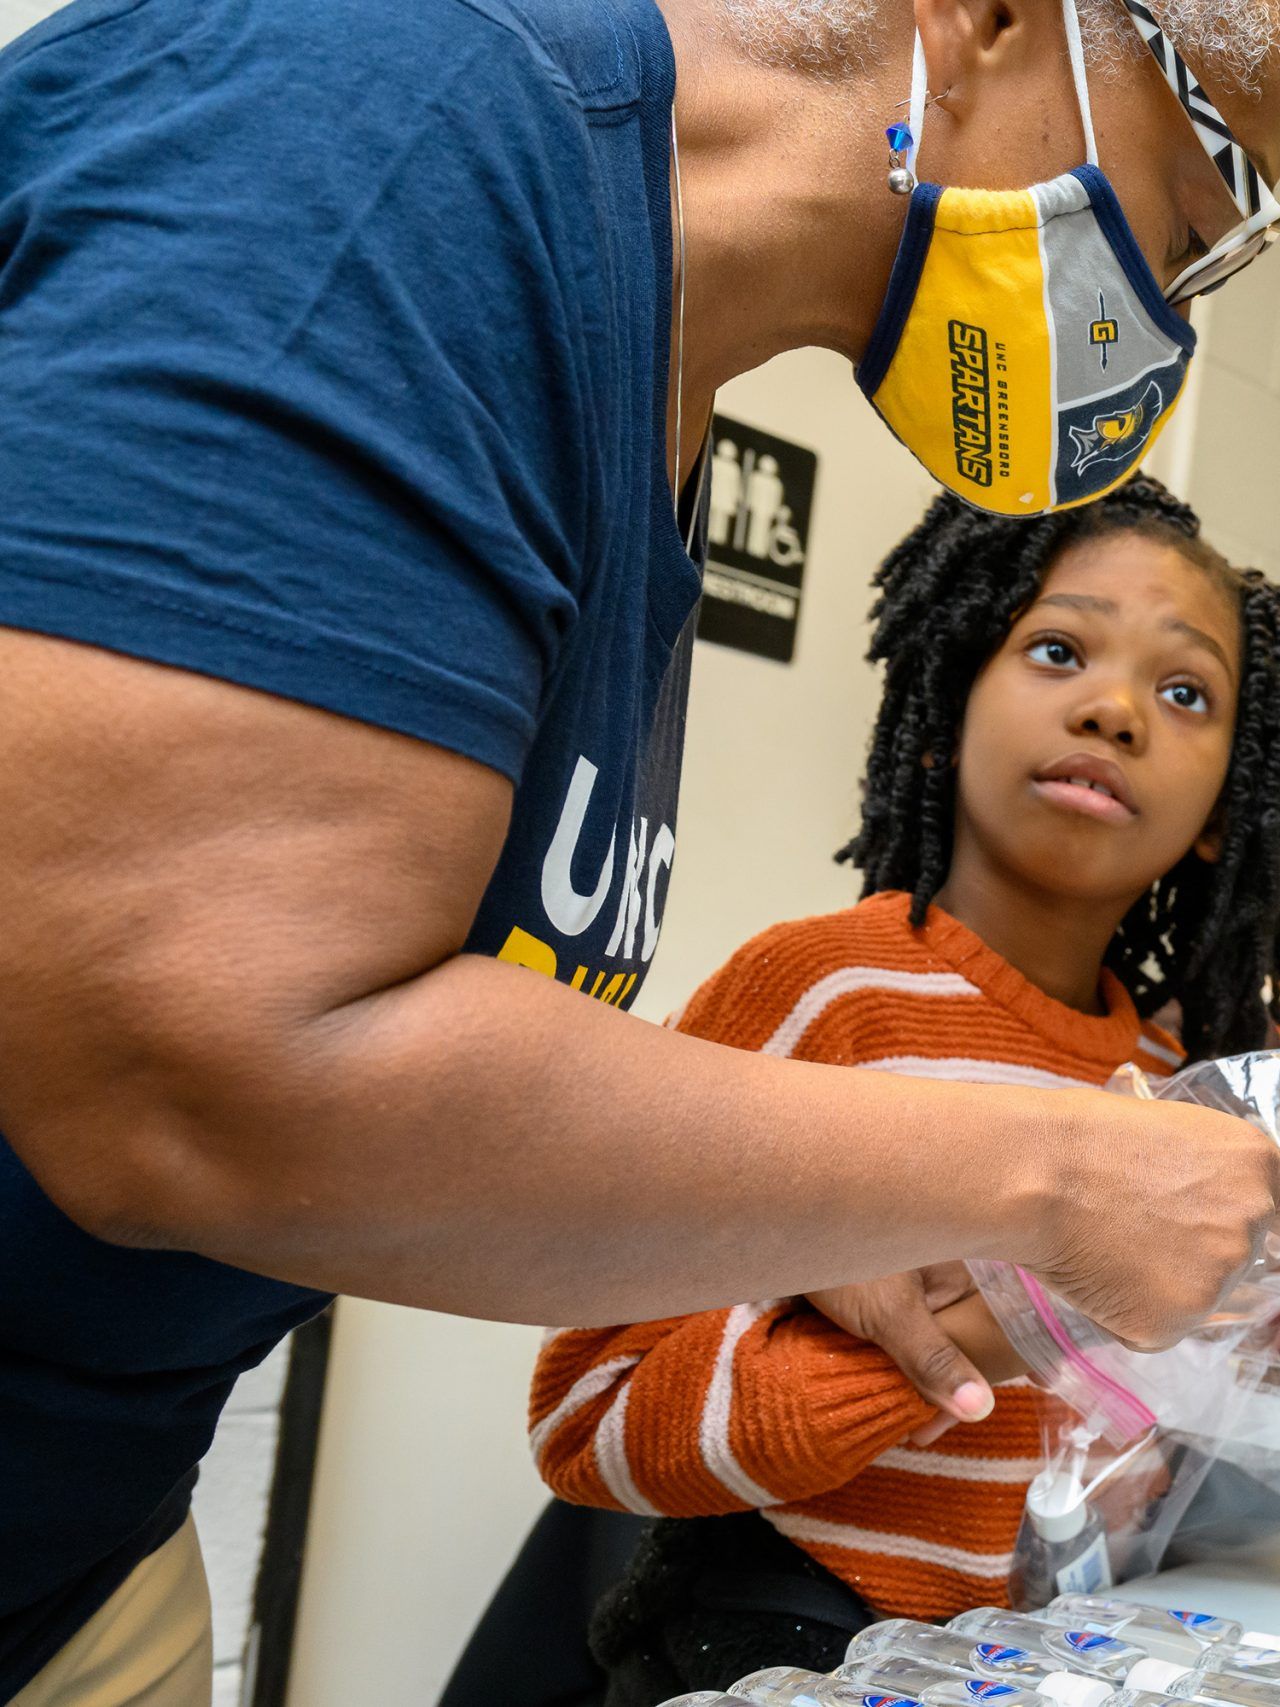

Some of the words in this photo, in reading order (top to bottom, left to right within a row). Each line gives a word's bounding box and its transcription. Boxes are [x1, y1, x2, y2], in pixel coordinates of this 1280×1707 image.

[947, 319, 992, 488] SPARTANS
[995, 342, 1007, 373] UNC
[996, 380, 1010, 478] GREENSBORO
[541, 754, 676, 963] UNC
